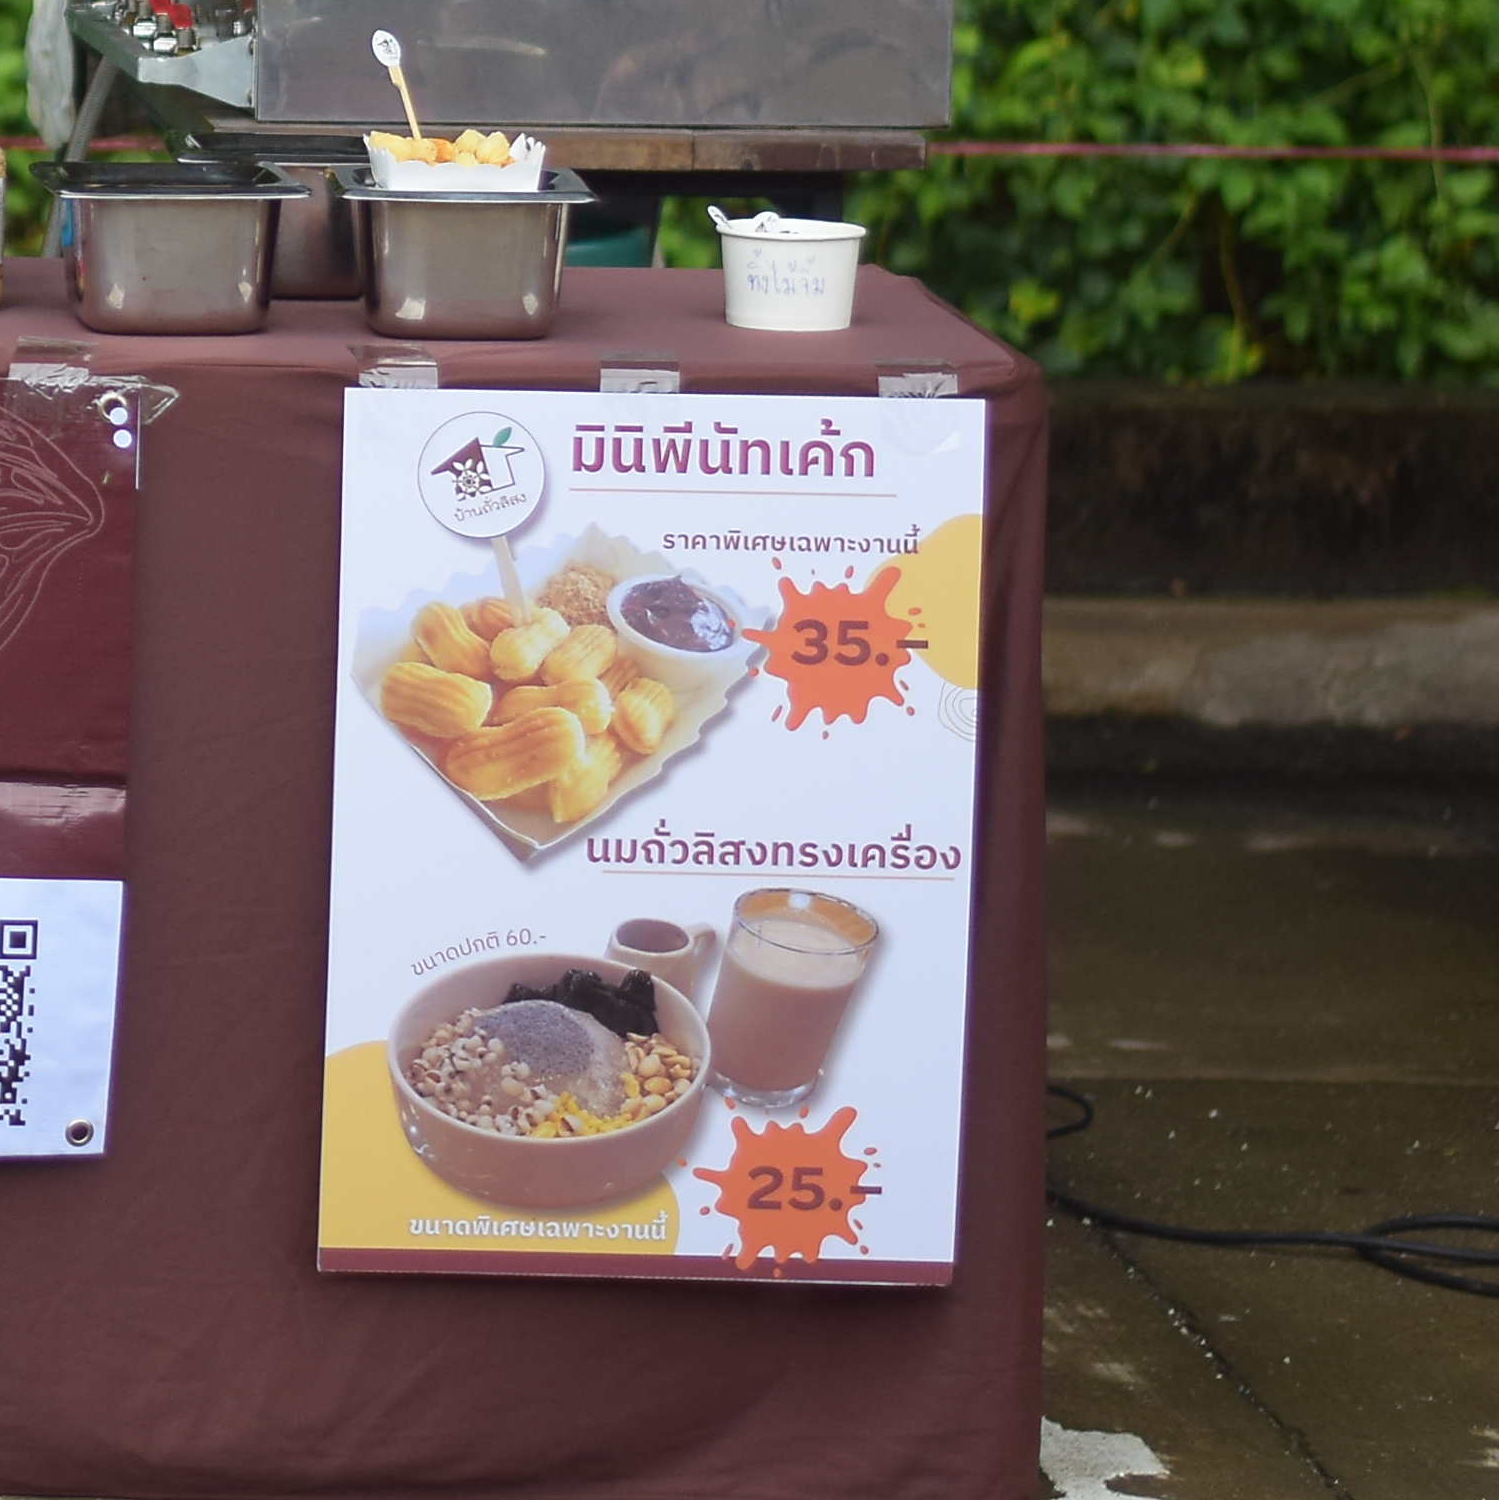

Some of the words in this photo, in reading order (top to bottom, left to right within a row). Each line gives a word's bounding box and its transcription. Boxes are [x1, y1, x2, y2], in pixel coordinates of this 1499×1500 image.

[570, 418, 876, 479] มินิพีนัทเค้ก
[453, 493, 527, 522] บ้านถั่วลิสง
[662, 524, 921, 555] ราคาพิเศษเฉพาะงานนี้
[790, 619, 929, 667] 35.-
[585, 819, 962, 871] นมถั่วลิสงทรงเครื่อง
[410, 931, 501, 976] ขนาดปกติ
[506, 928, 547, 947] 60.-
[746, 1165, 883, 1212] 25.-
[409, 1210, 669, 1241] ขนาดพิเศษเฉพาะงานนี้
